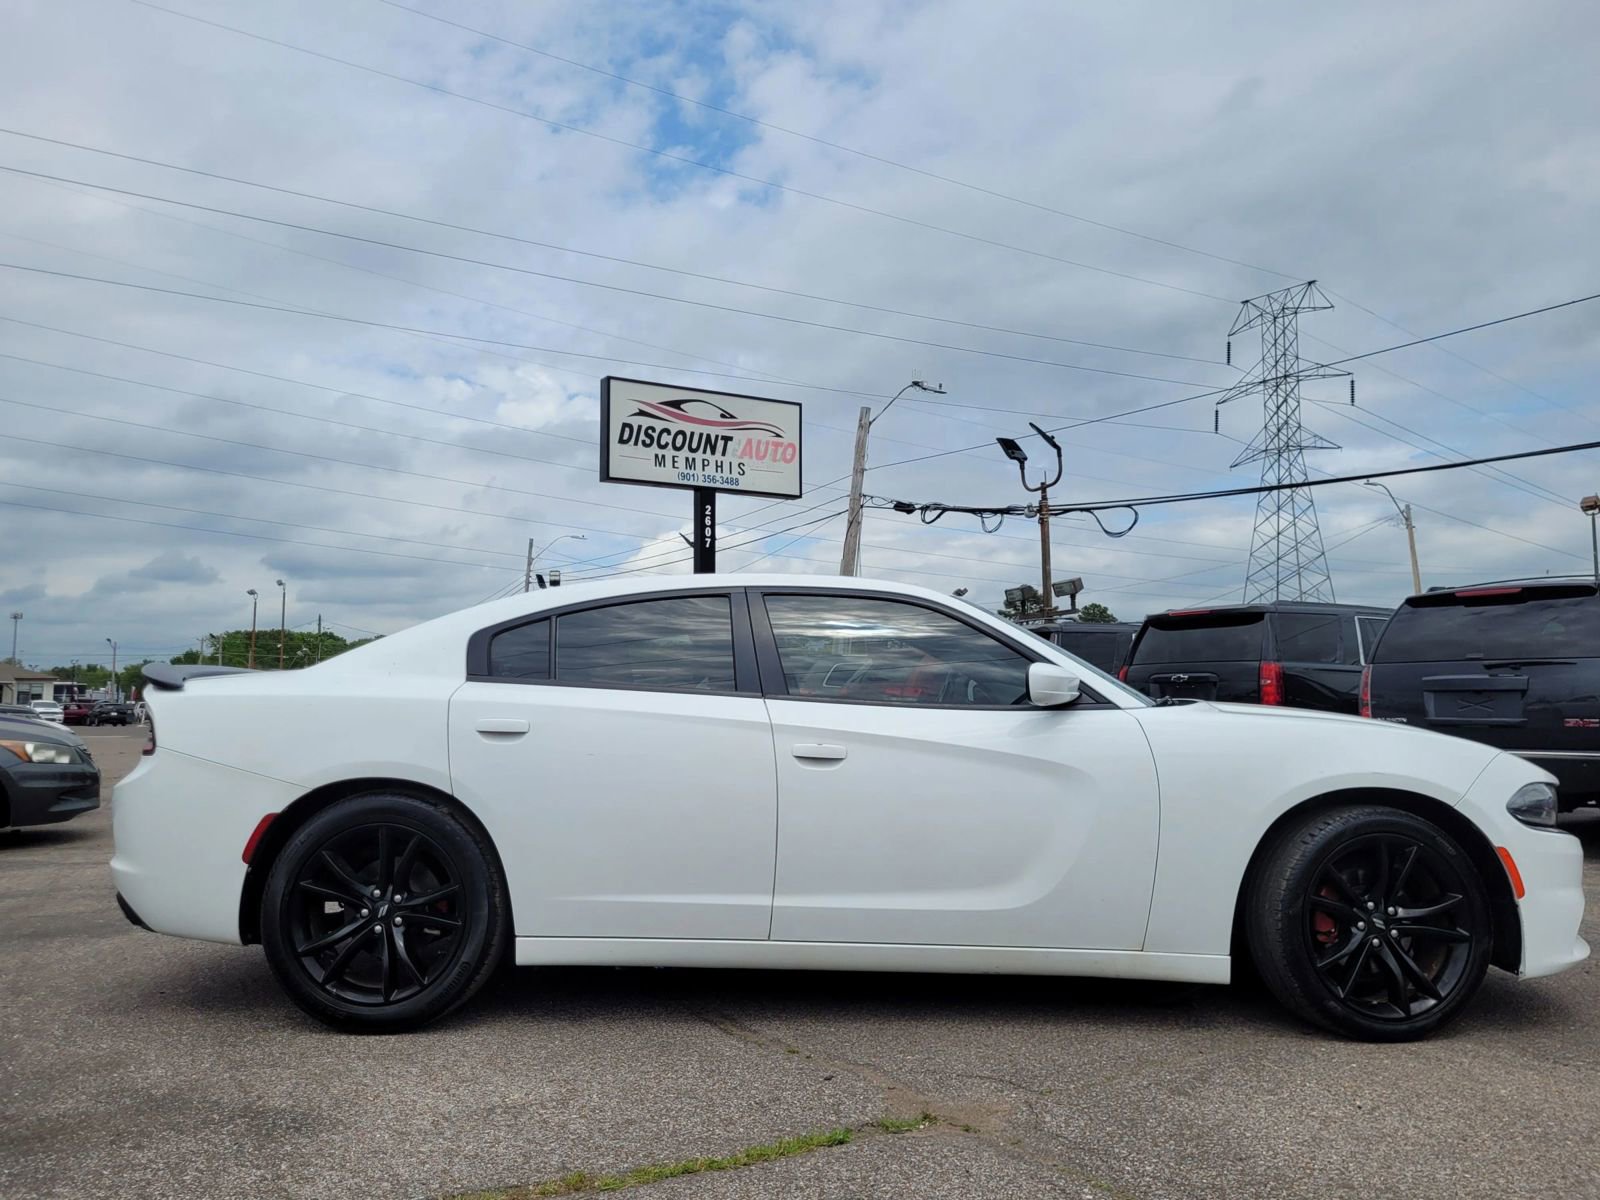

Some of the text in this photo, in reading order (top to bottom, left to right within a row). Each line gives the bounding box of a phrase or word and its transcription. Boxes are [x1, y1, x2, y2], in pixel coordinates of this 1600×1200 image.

[618, 422, 797, 464] DISCOUNT AUTO
[654, 453, 746, 476] MEMPHIS
[677, 471, 740, 487] (901) 356-3488
[704, 505, 712, 548] 2607
